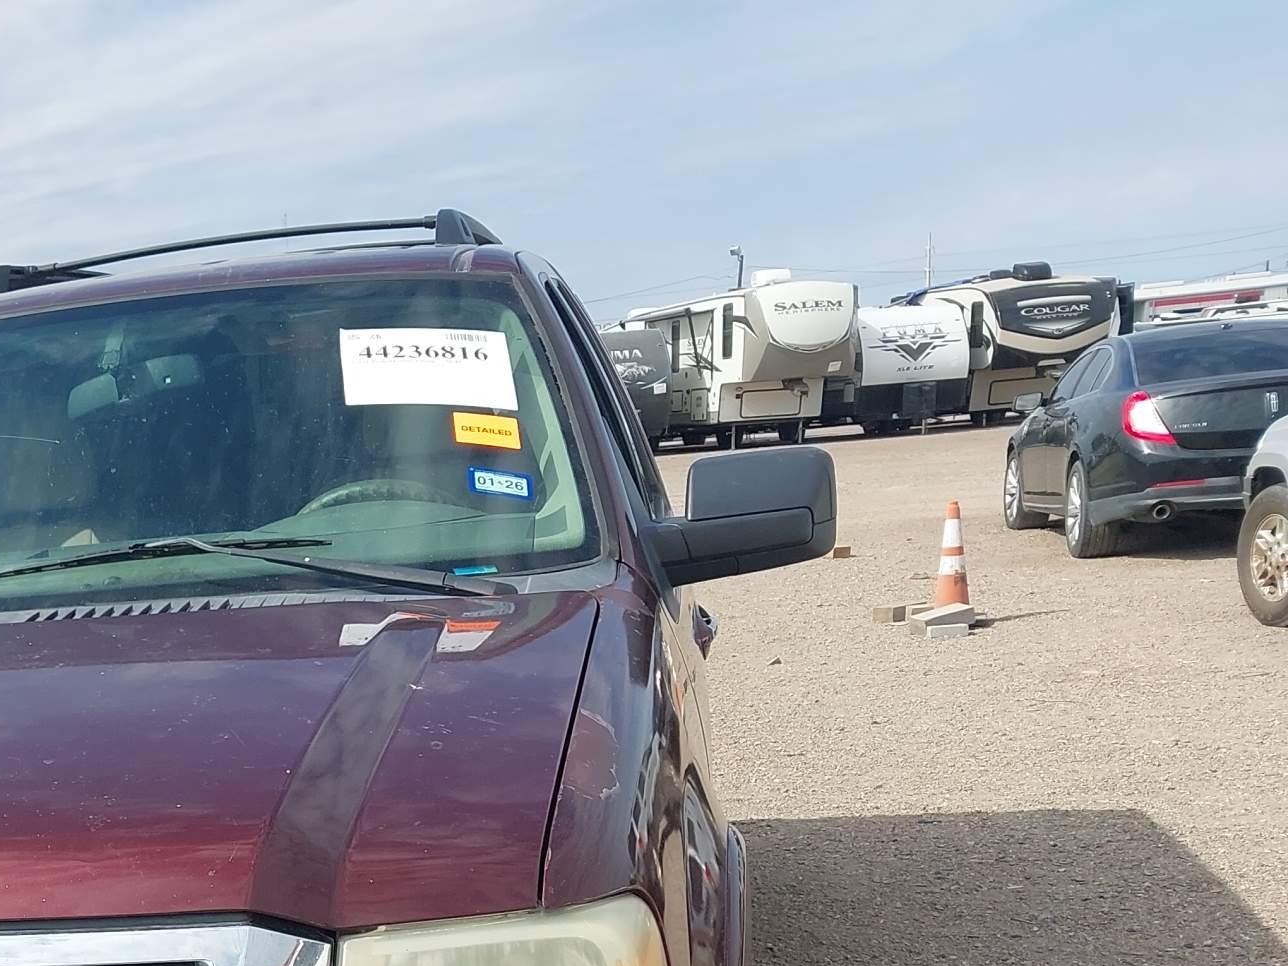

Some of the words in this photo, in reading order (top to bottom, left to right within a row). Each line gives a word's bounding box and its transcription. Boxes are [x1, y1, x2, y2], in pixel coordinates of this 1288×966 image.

[774, 300, 844, 312] SALEM
[1020, 303, 1091, 316] COUGAR
[359, 344, 489, 361] 44236816
[461, 425, 512, 437] DETAILED
